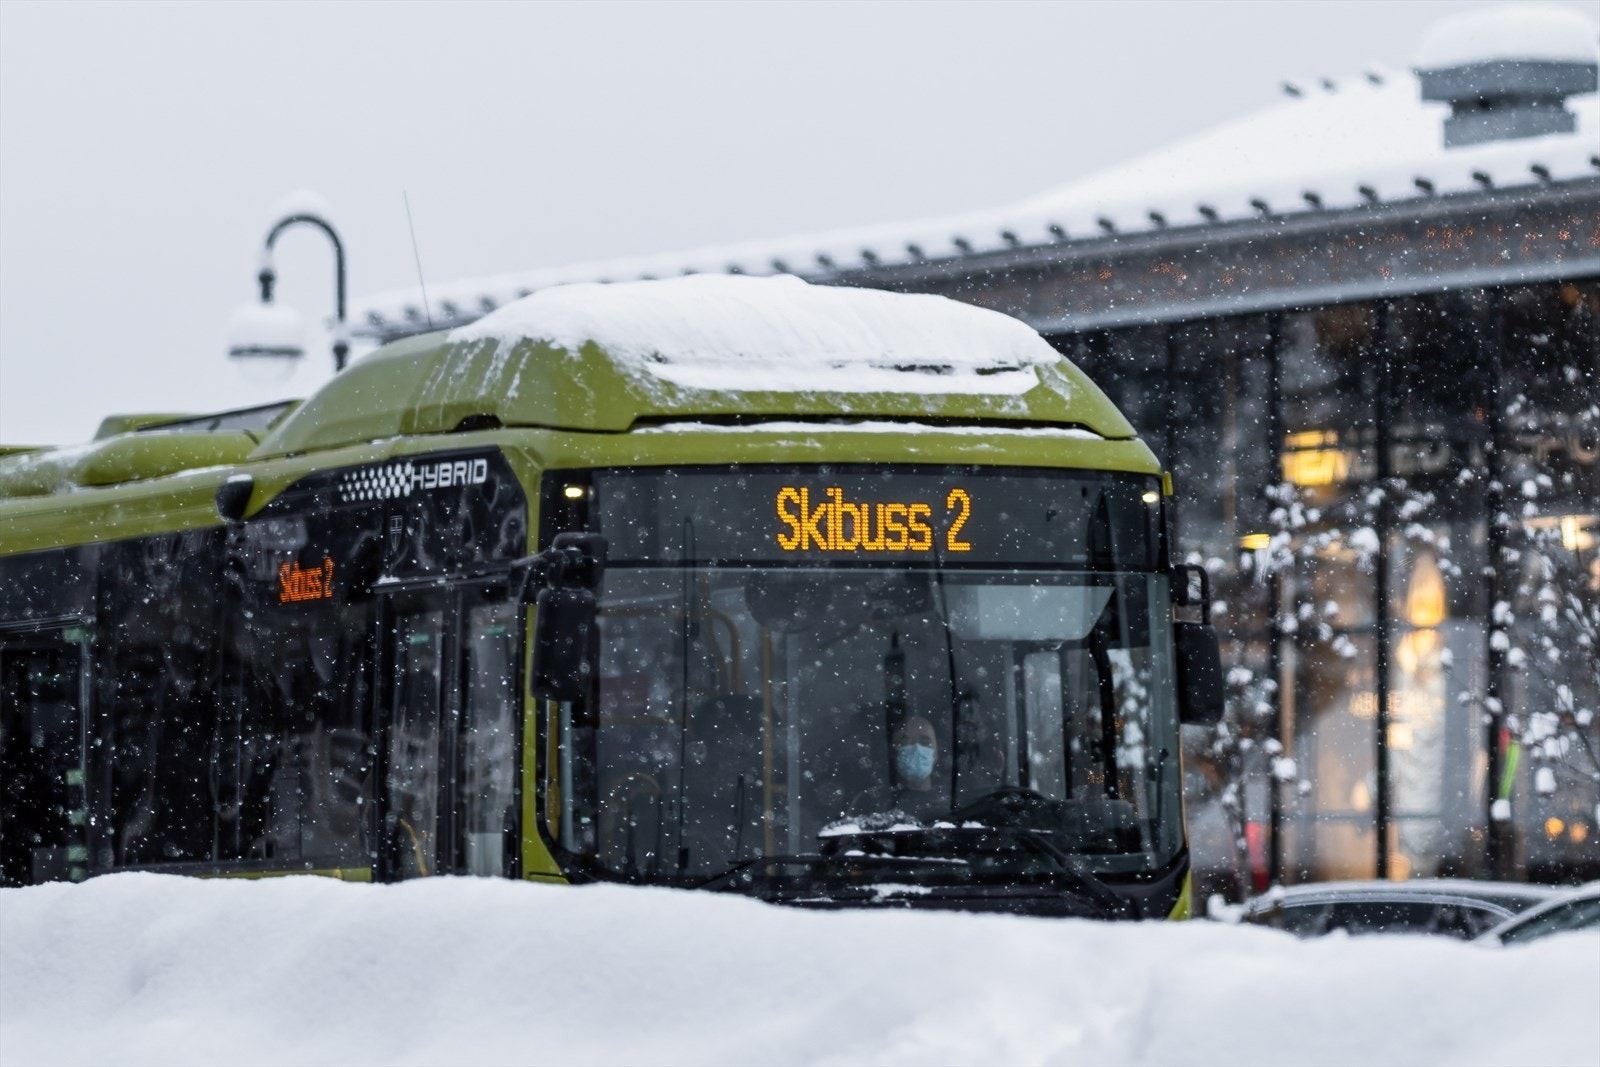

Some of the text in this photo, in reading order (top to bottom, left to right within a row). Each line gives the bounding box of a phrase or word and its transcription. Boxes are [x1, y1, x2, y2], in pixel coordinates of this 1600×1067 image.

[410, 458, 488, 491] HYBRID
[776, 487, 971, 551] Skibuss 2
[324, 556, 333, 598] 2
